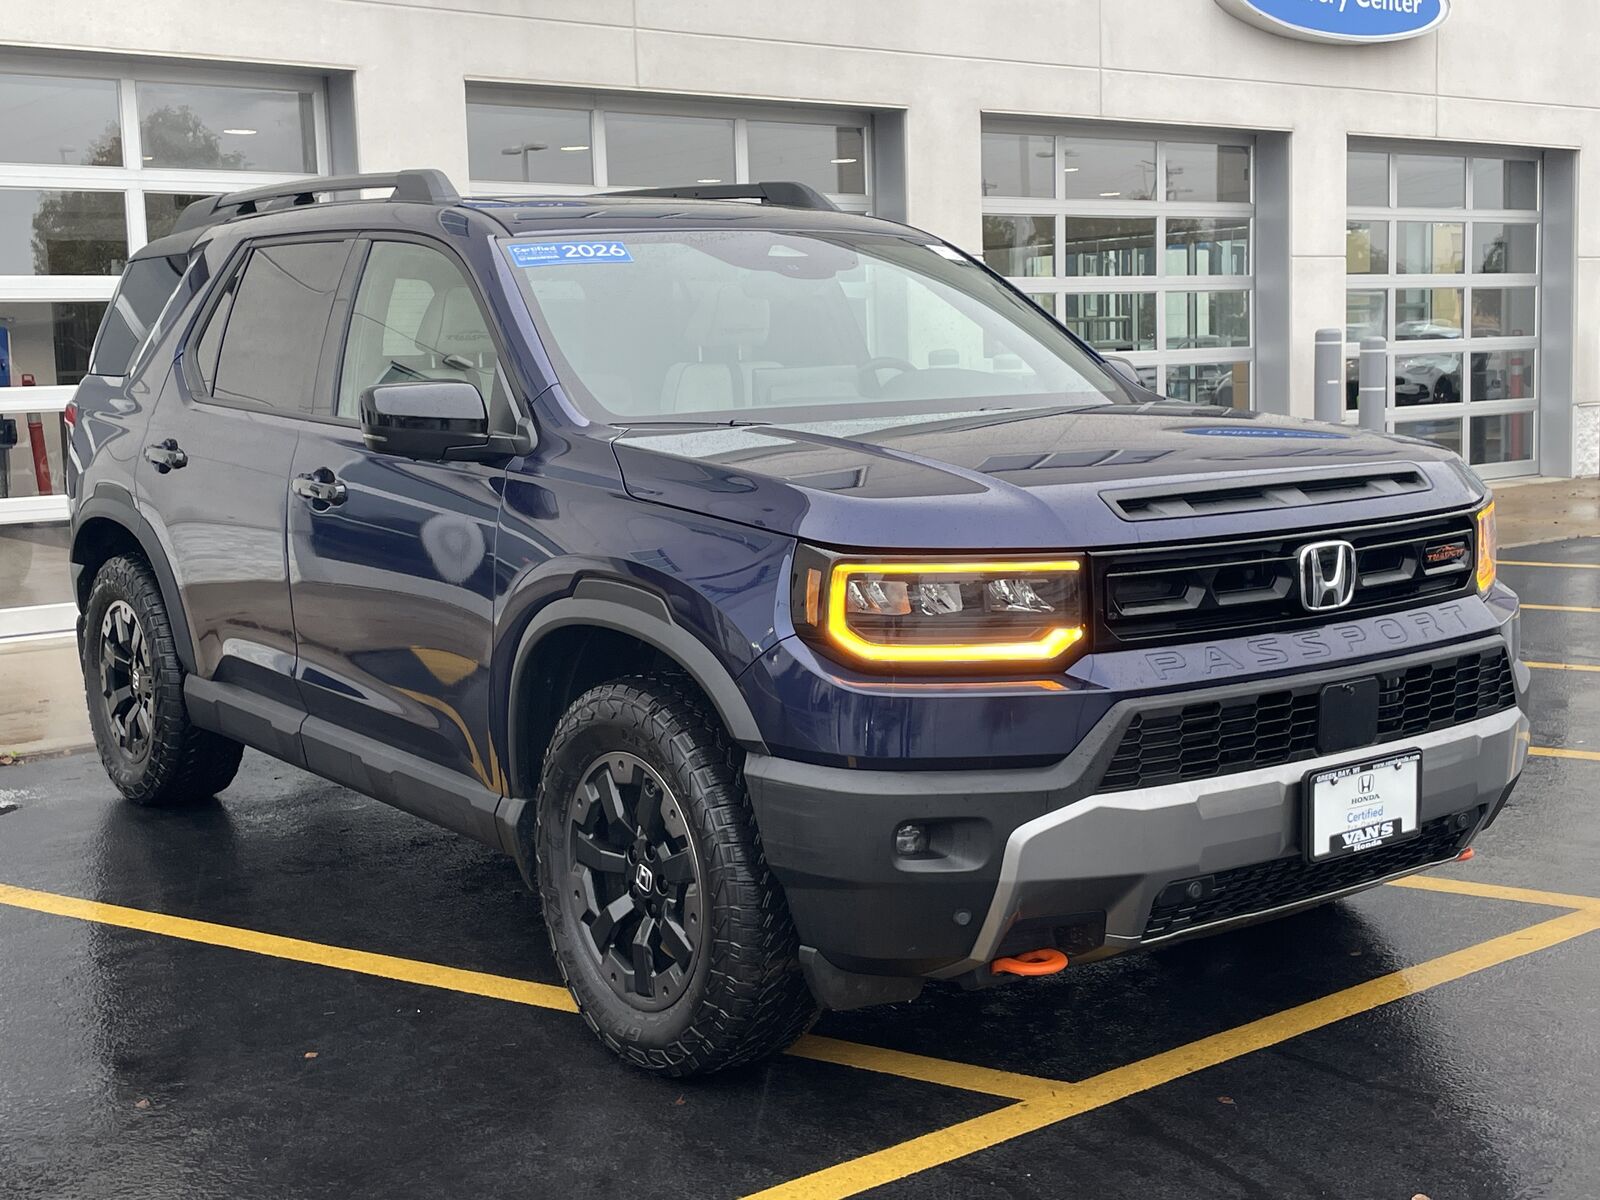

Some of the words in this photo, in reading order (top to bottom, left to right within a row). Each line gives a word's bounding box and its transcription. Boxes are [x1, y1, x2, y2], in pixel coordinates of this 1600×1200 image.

[513, 244, 556, 253] Certified
[561, 244, 626, 258] 2026
[1144, 605, 1467, 680] PASSPORT
[1316, 771, 1337, 783] GREEN
[1351, 793, 1380, 804] HONDA
[1347, 805, 1384, 823] Certified
[1353, 840, 1382, 852] Honda
